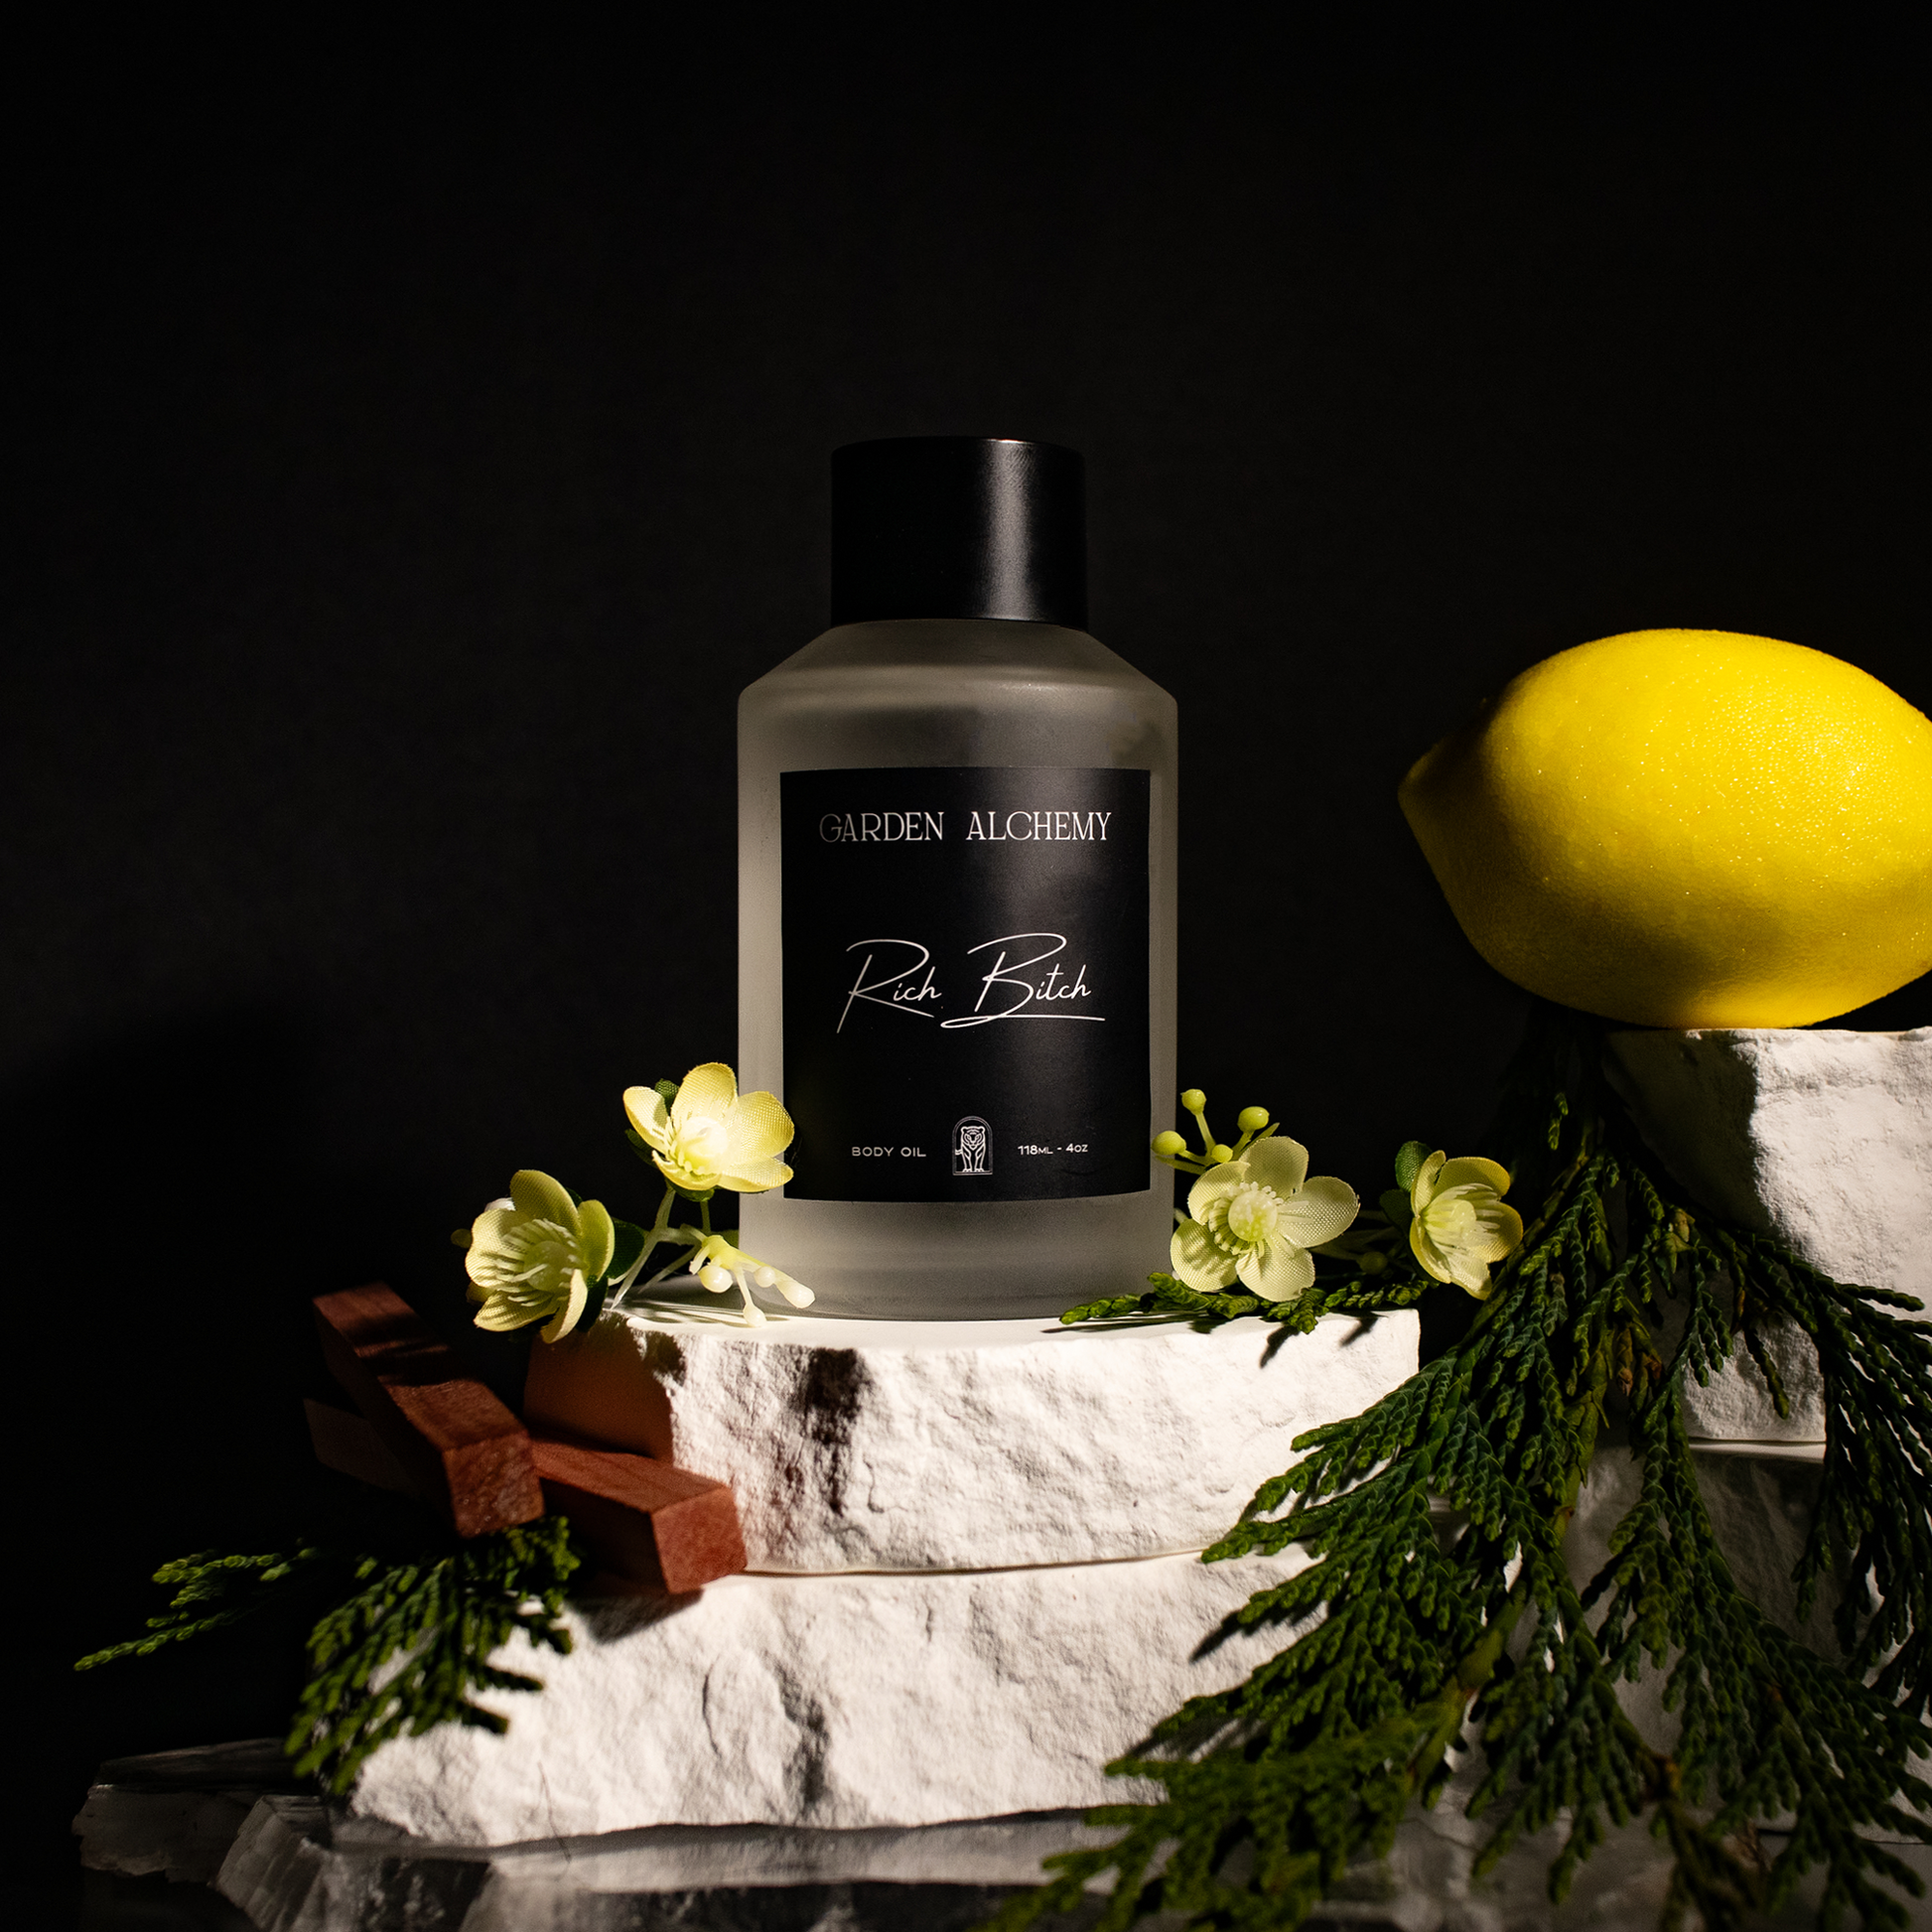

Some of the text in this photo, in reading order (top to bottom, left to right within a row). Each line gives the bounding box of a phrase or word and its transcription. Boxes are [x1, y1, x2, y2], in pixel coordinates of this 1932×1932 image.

[818, 811, 1112, 843] GARDEN ALCHEMY
[836, 931, 1106, 1034] Rich Bitch
[851, 1147, 927, 1158] BODY OIL
